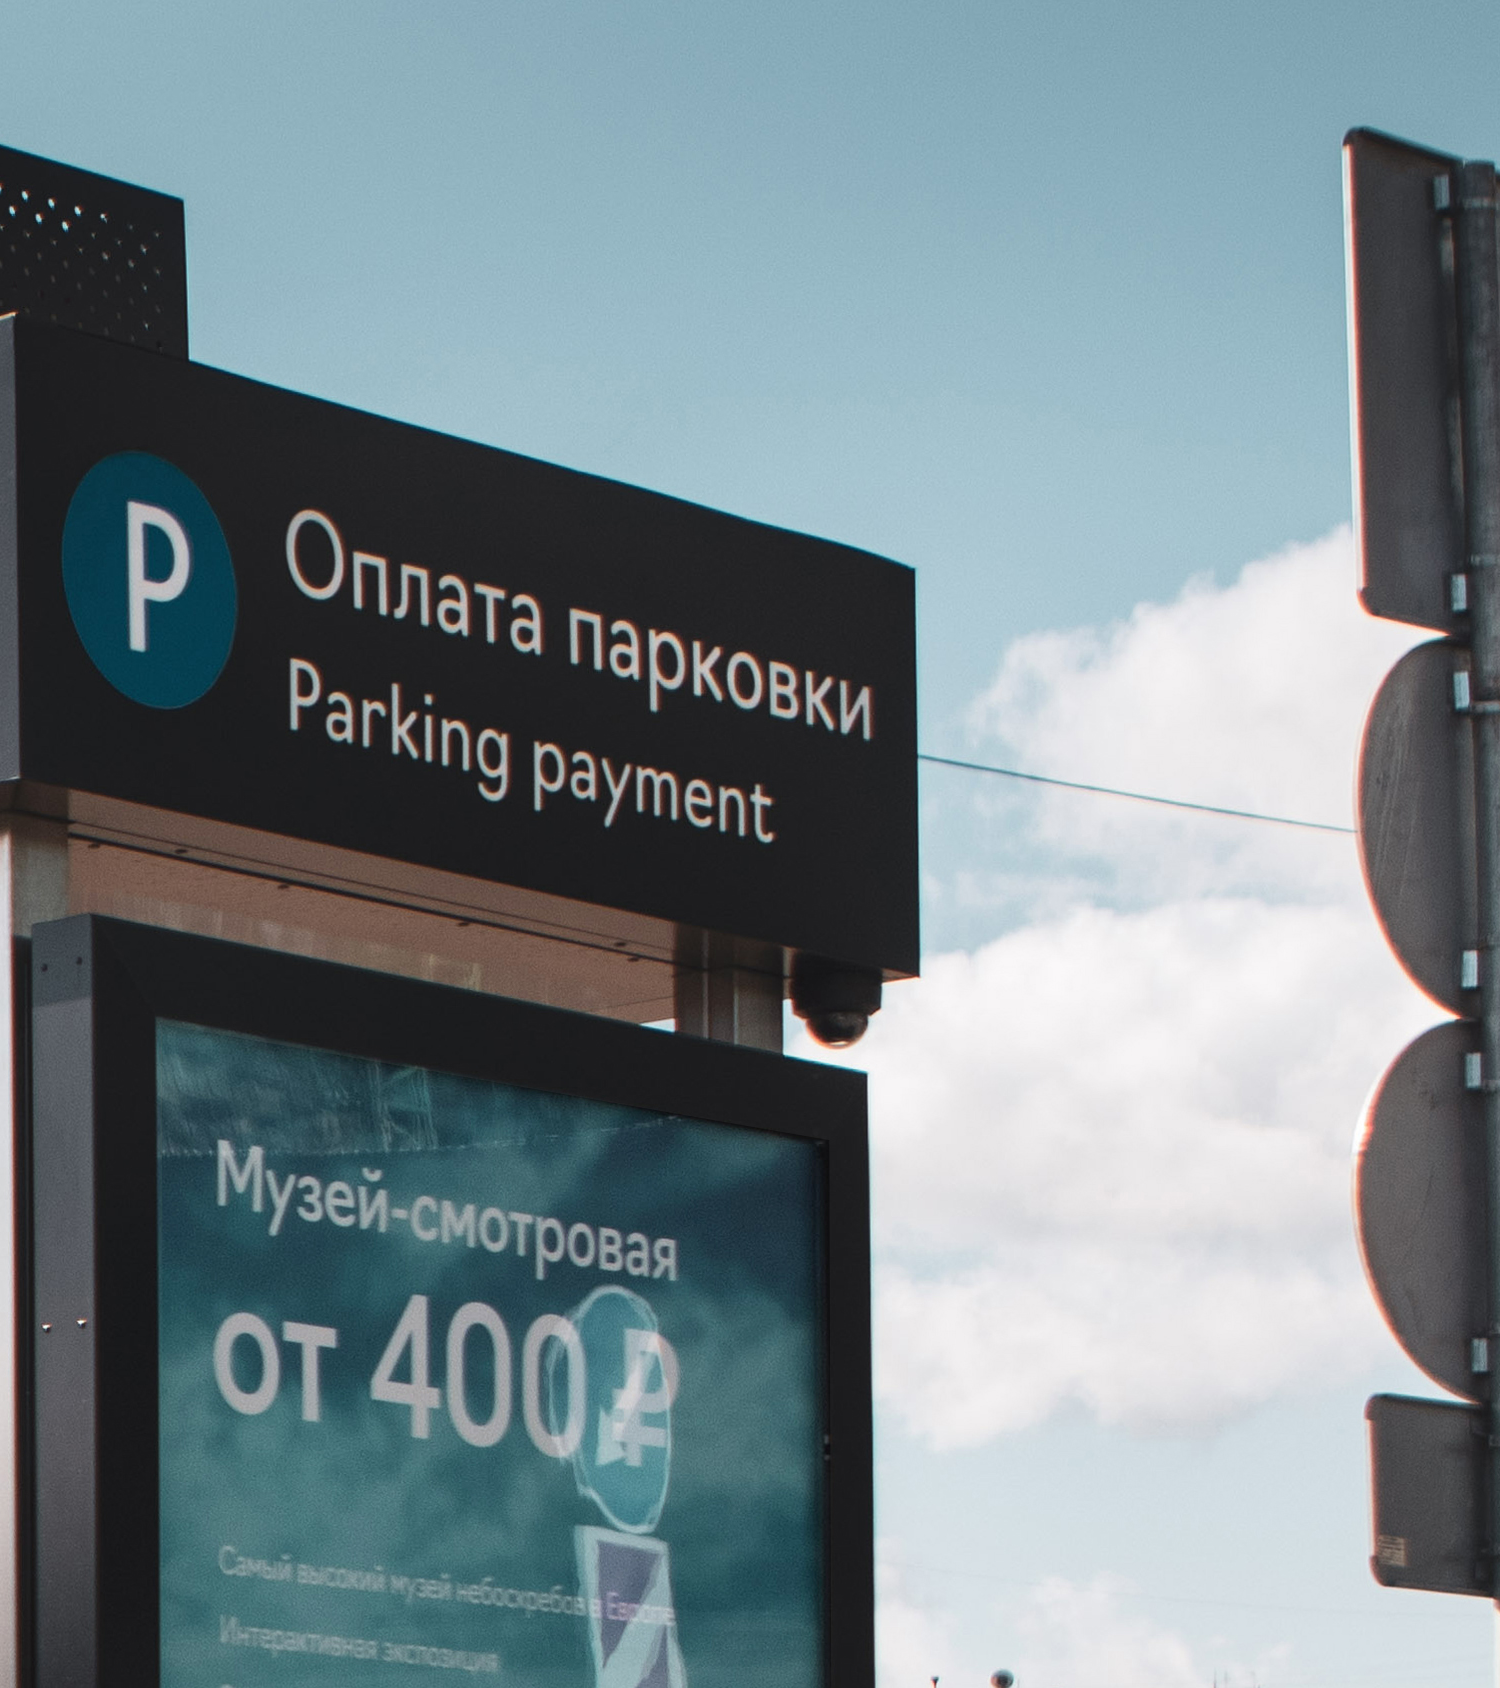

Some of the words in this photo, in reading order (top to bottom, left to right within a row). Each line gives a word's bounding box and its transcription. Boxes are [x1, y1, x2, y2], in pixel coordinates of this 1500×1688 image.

[126, 501, 191, 653] P
[286, 509, 544, 655] Оплата
[568, 608, 874, 741] парковки
[288, 657, 510, 801] Parking
[533, 740, 776, 845] payment
[216, 1138, 678, 1281] Музей-смотровая
[212, 1311, 338, 1423] от
[218, 1613, 379, 1661] Интерактивная
[380, 1641, 500, 1674] экспозиция
[219, 1544, 293, 1582] Самый
[296, 1564, 386, 1593] высокий
[388, 1574, 454, 1606] музей
